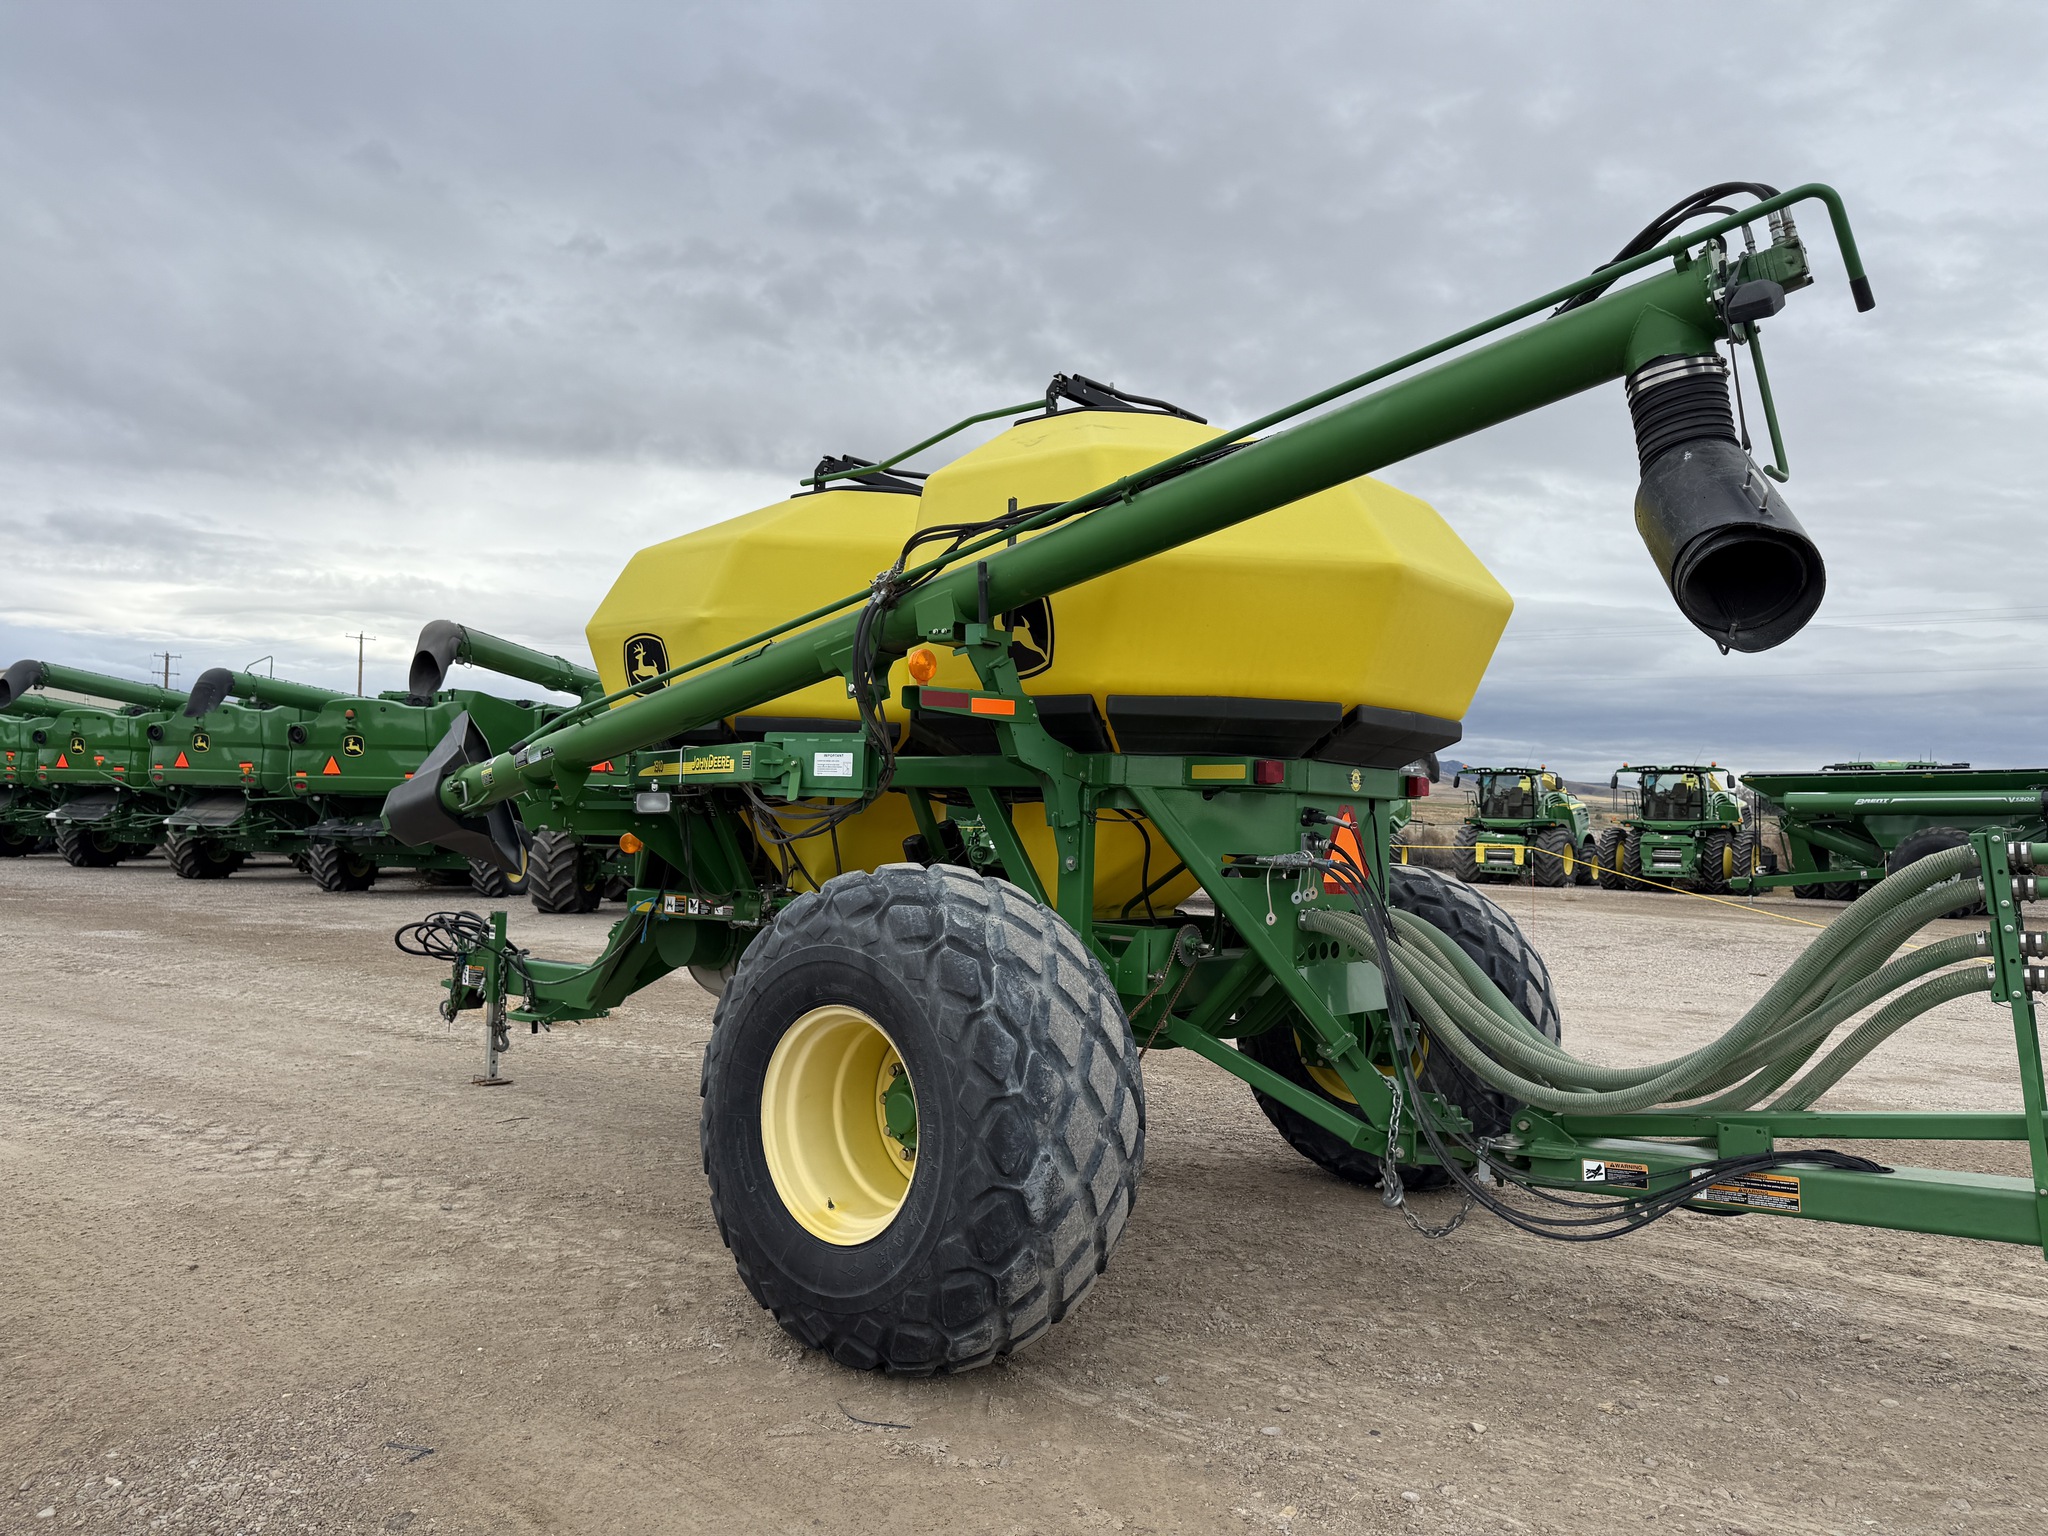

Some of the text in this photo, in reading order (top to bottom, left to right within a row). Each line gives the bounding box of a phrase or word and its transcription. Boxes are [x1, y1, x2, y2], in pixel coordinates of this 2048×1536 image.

[692, 755, 709, 770] JOHN
[709, 754, 731, 769] DEERE
[2008, 796, 2036, 804] V1300
[1615, 1163, 1643, 1171] WARNING
[1741, 1188, 1769, 1196] WARNING
